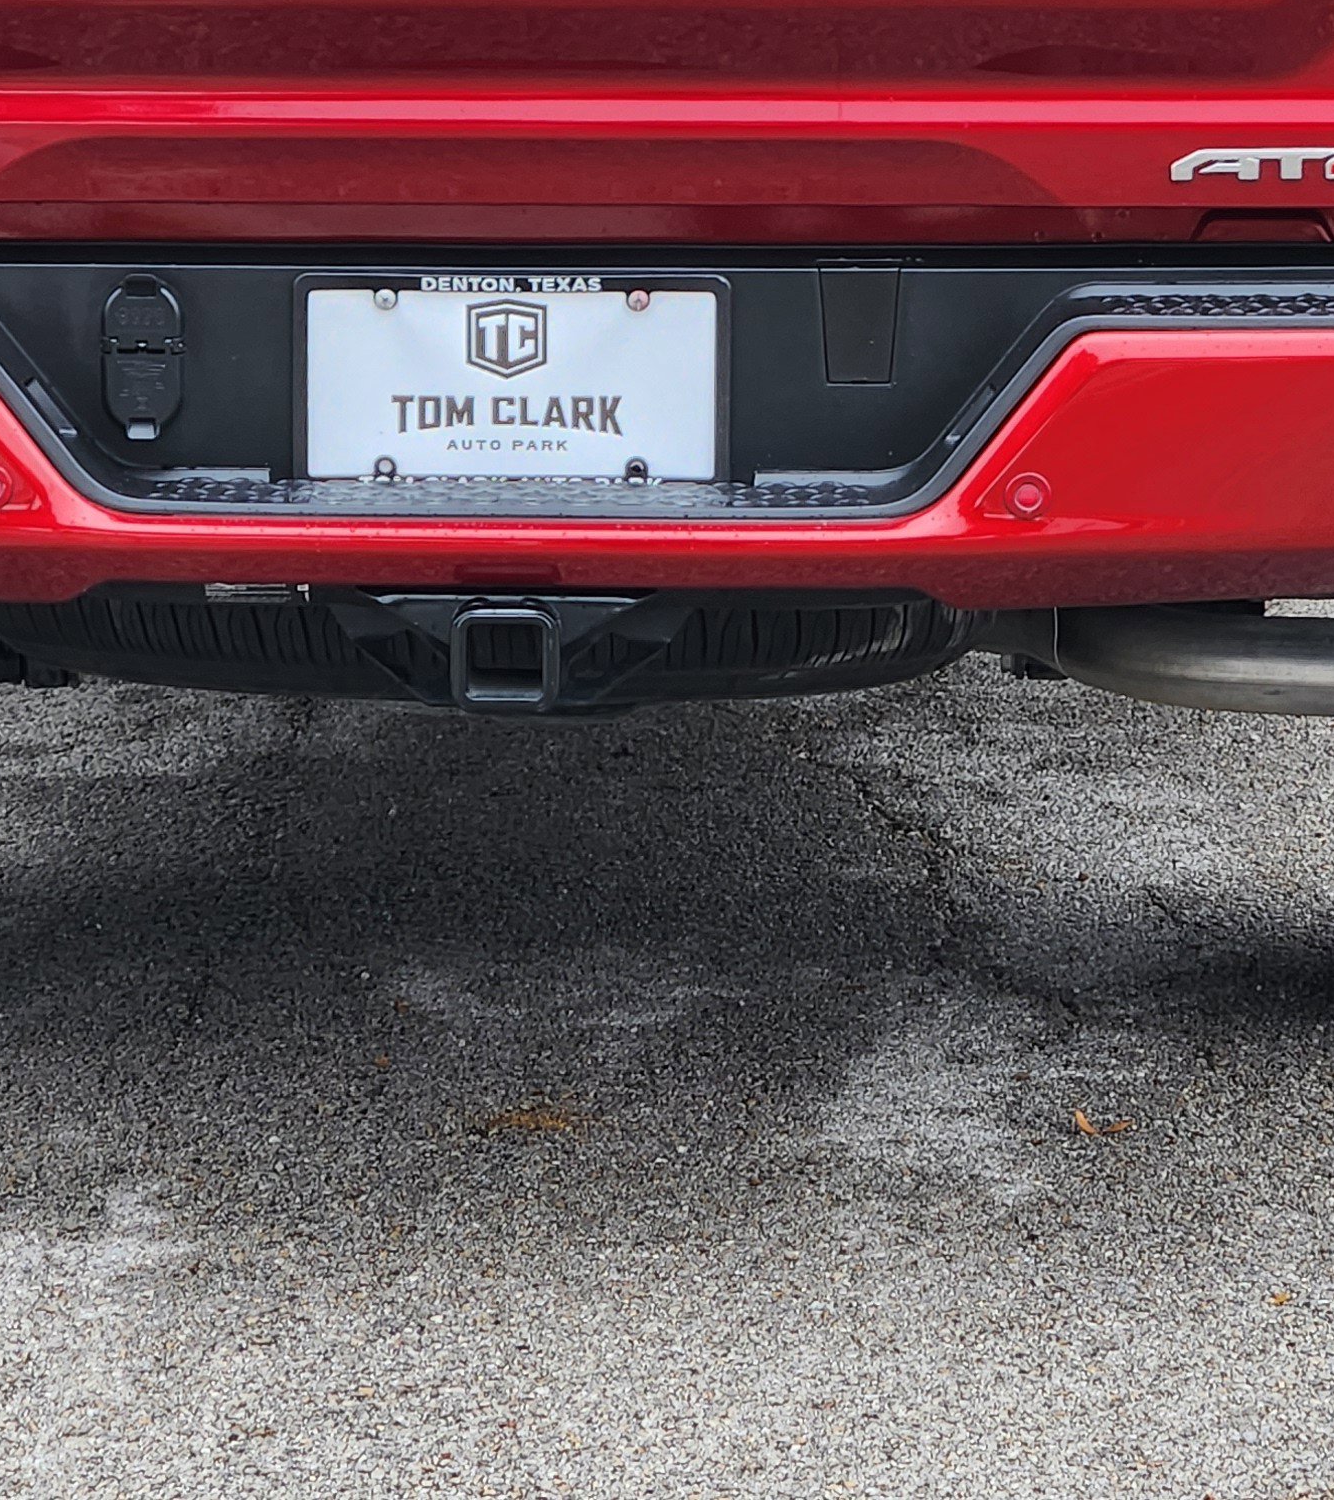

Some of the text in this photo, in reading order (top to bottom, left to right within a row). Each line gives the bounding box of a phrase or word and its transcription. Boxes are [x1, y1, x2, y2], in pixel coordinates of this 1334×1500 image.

[527, 277, 603, 293] TEXAS
[478, 313, 537, 363] TC
[391, 395, 623, 437] TOM CLARK
[446, 440, 569, 451] AUTO PARK
